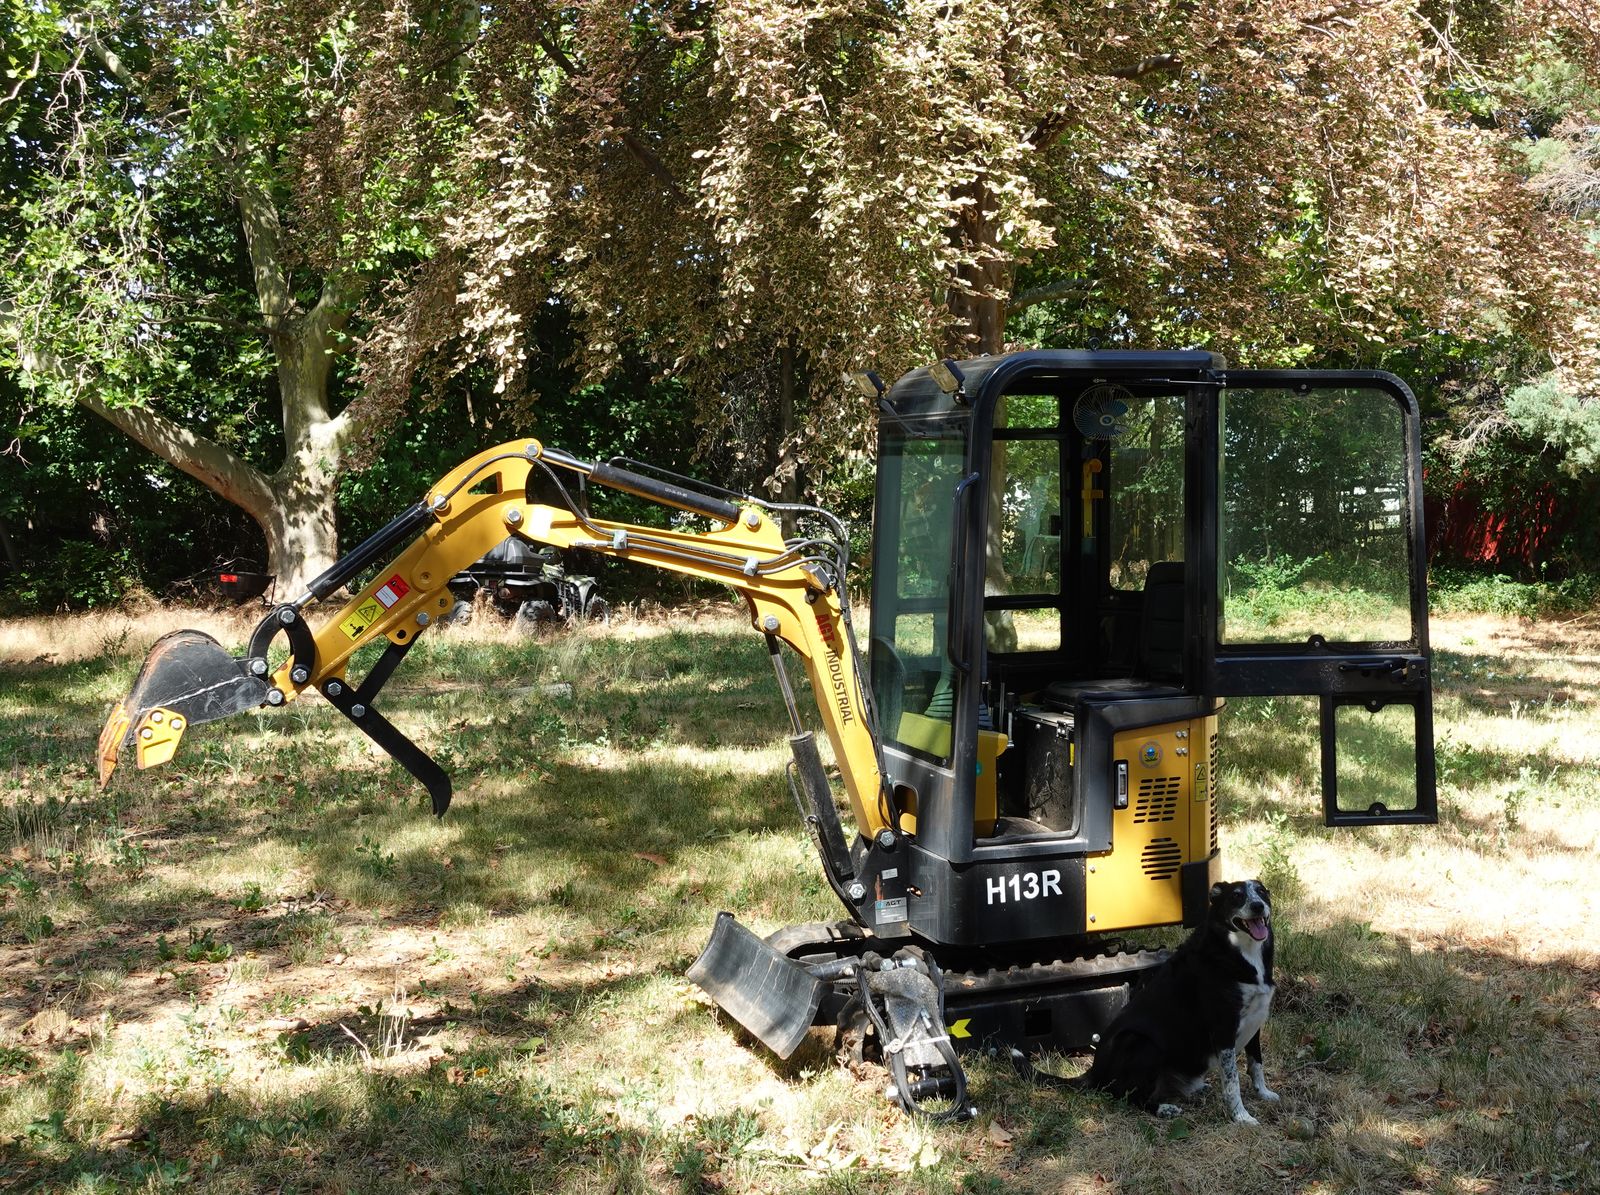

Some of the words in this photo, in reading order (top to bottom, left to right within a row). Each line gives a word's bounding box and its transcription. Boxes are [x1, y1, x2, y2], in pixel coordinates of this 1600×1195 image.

[815, 613, 835, 642] AGT
[825, 648, 854, 726] INDUSTRIAL
[885, 900, 901, 908] AGT
[986, 869, 1063, 905] H13R
